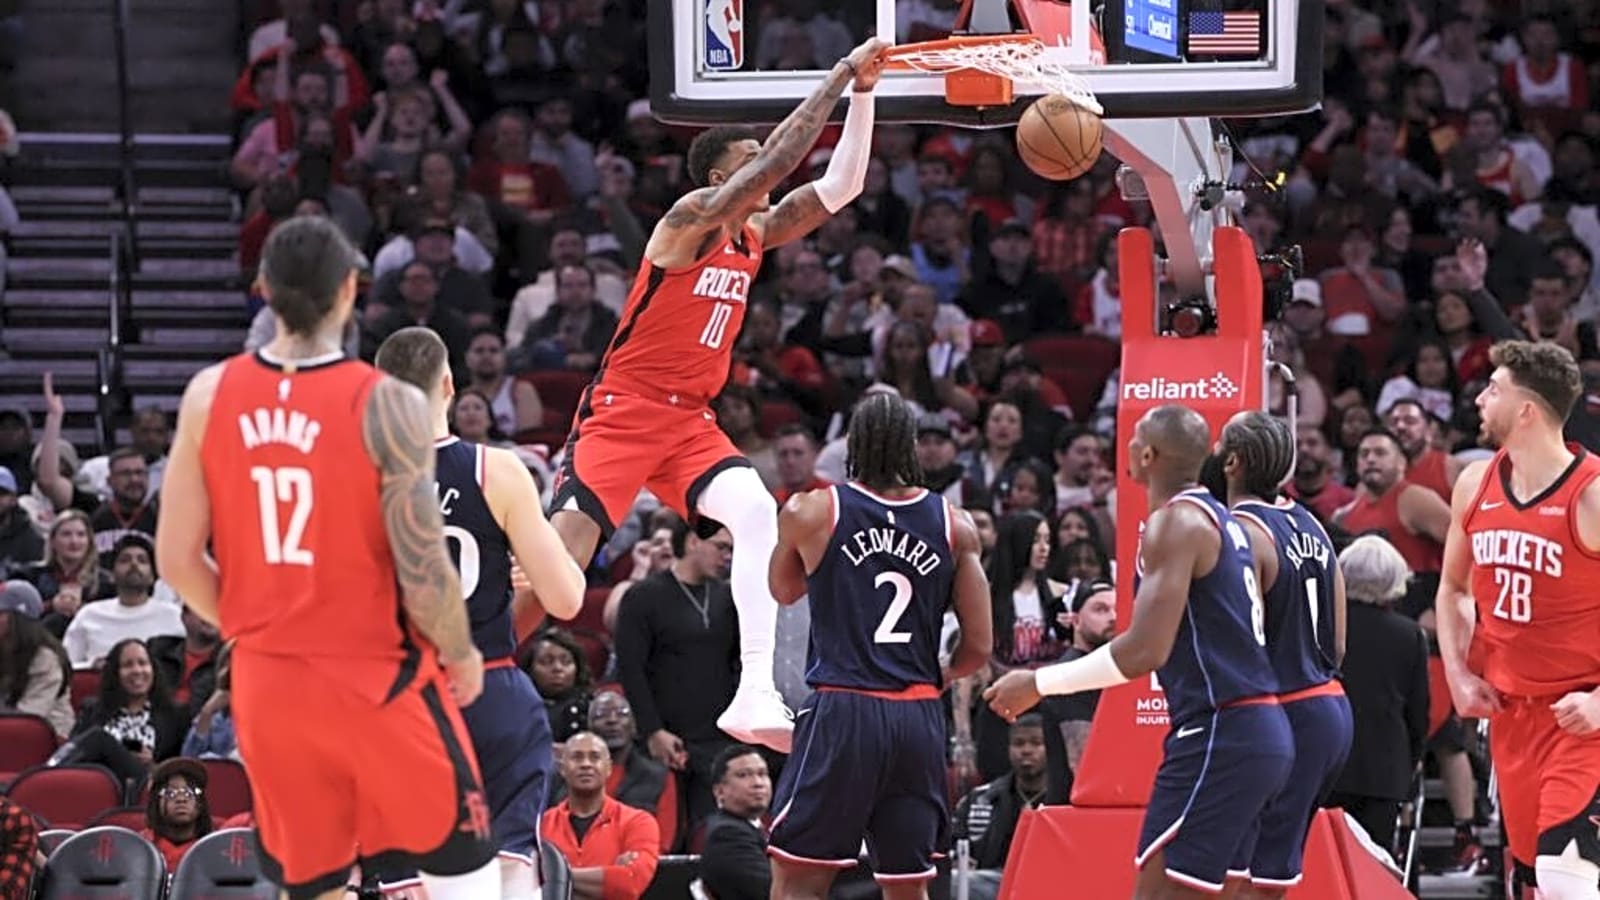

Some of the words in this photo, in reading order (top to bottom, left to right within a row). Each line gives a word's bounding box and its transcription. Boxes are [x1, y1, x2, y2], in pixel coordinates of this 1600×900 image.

[709, 49, 729, 64] NBA
[699, 301, 733, 349] 10
[1123, 377, 1209, 400] reliant
[238, 407, 321, 454] ADAMS
[251, 465, 315, 567] 12
[840, 527, 941, 576] LEONARD
[1471, 529, 1563, 578] ROCKETS
[873, 571, 913, 644] 2
[1243, 566, 1266, 648] 8
[1305, 577, 1319, 645] 1
[1492, 566, 1532, 624] 28
